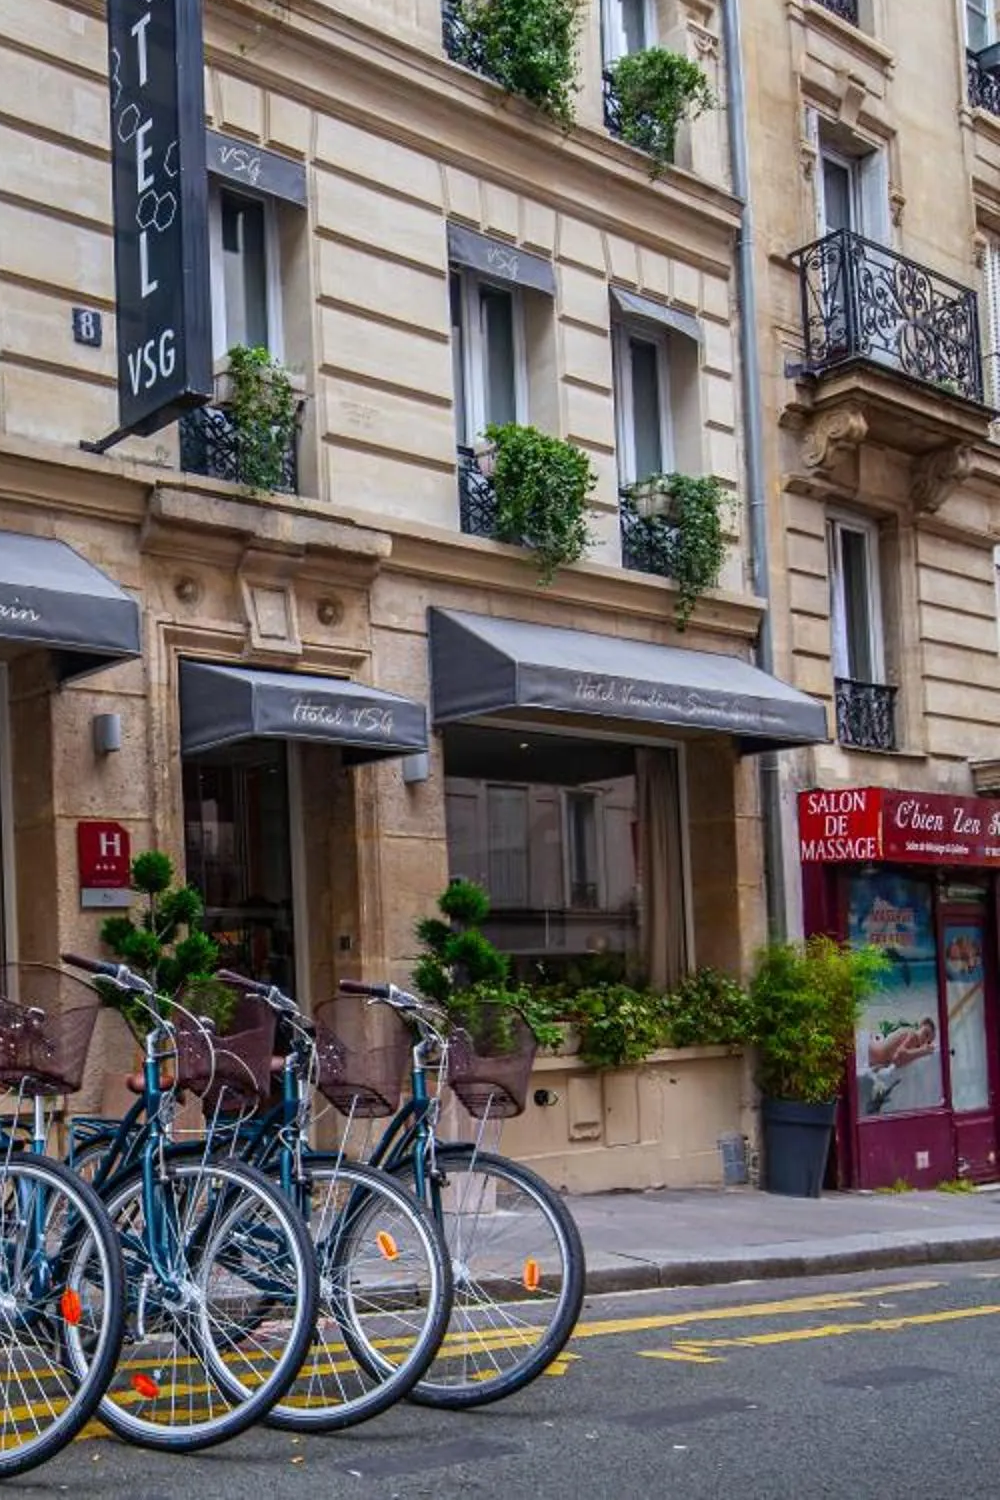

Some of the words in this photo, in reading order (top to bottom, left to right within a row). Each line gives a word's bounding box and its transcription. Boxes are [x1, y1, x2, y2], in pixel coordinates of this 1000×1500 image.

[217, 145, 262, 187] VSG
[486, 246, 520, 281] VSG
[80, 310, 96, 340] 8
[127, 328, 176, 397] VSG
[349, 706, 394, 737] VSG
[808, 791, 867, 815] SALON
[825, 815, 849, 837] DE
[953, 807, 981, 834] Zen
[100, 832, 121, 857] H
[801, 837, 877, 861] MASSAGE
